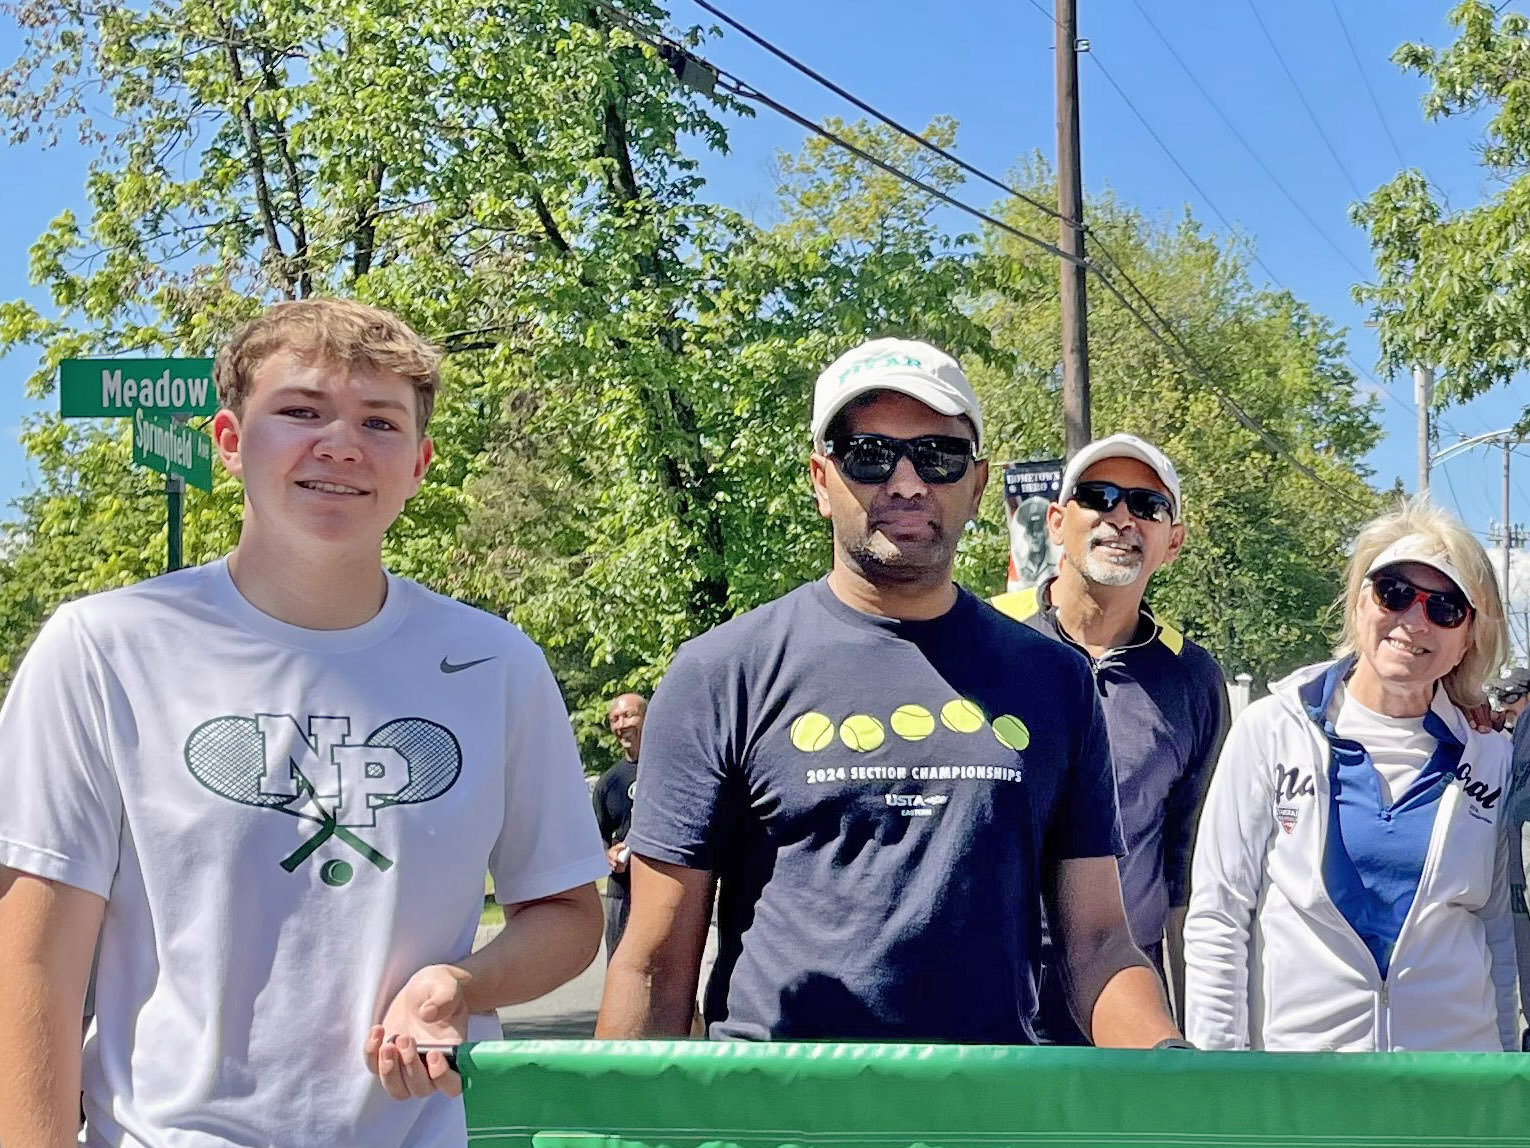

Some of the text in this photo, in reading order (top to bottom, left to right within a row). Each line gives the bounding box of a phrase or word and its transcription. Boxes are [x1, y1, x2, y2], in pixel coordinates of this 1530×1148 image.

[102, 369, 208, 408] Meadow
[136, 408, 193, 471] Springfield
[1007, 471, 1060, 484] HOMETOWN
[1021, 482, 1048, 493] HERO
[255, 713, 412, 827] NP
[806, 765, 1022, 784] 2024 SECTION CHAMPIONSHIPS
[885, 793, 926, 807] USTA
